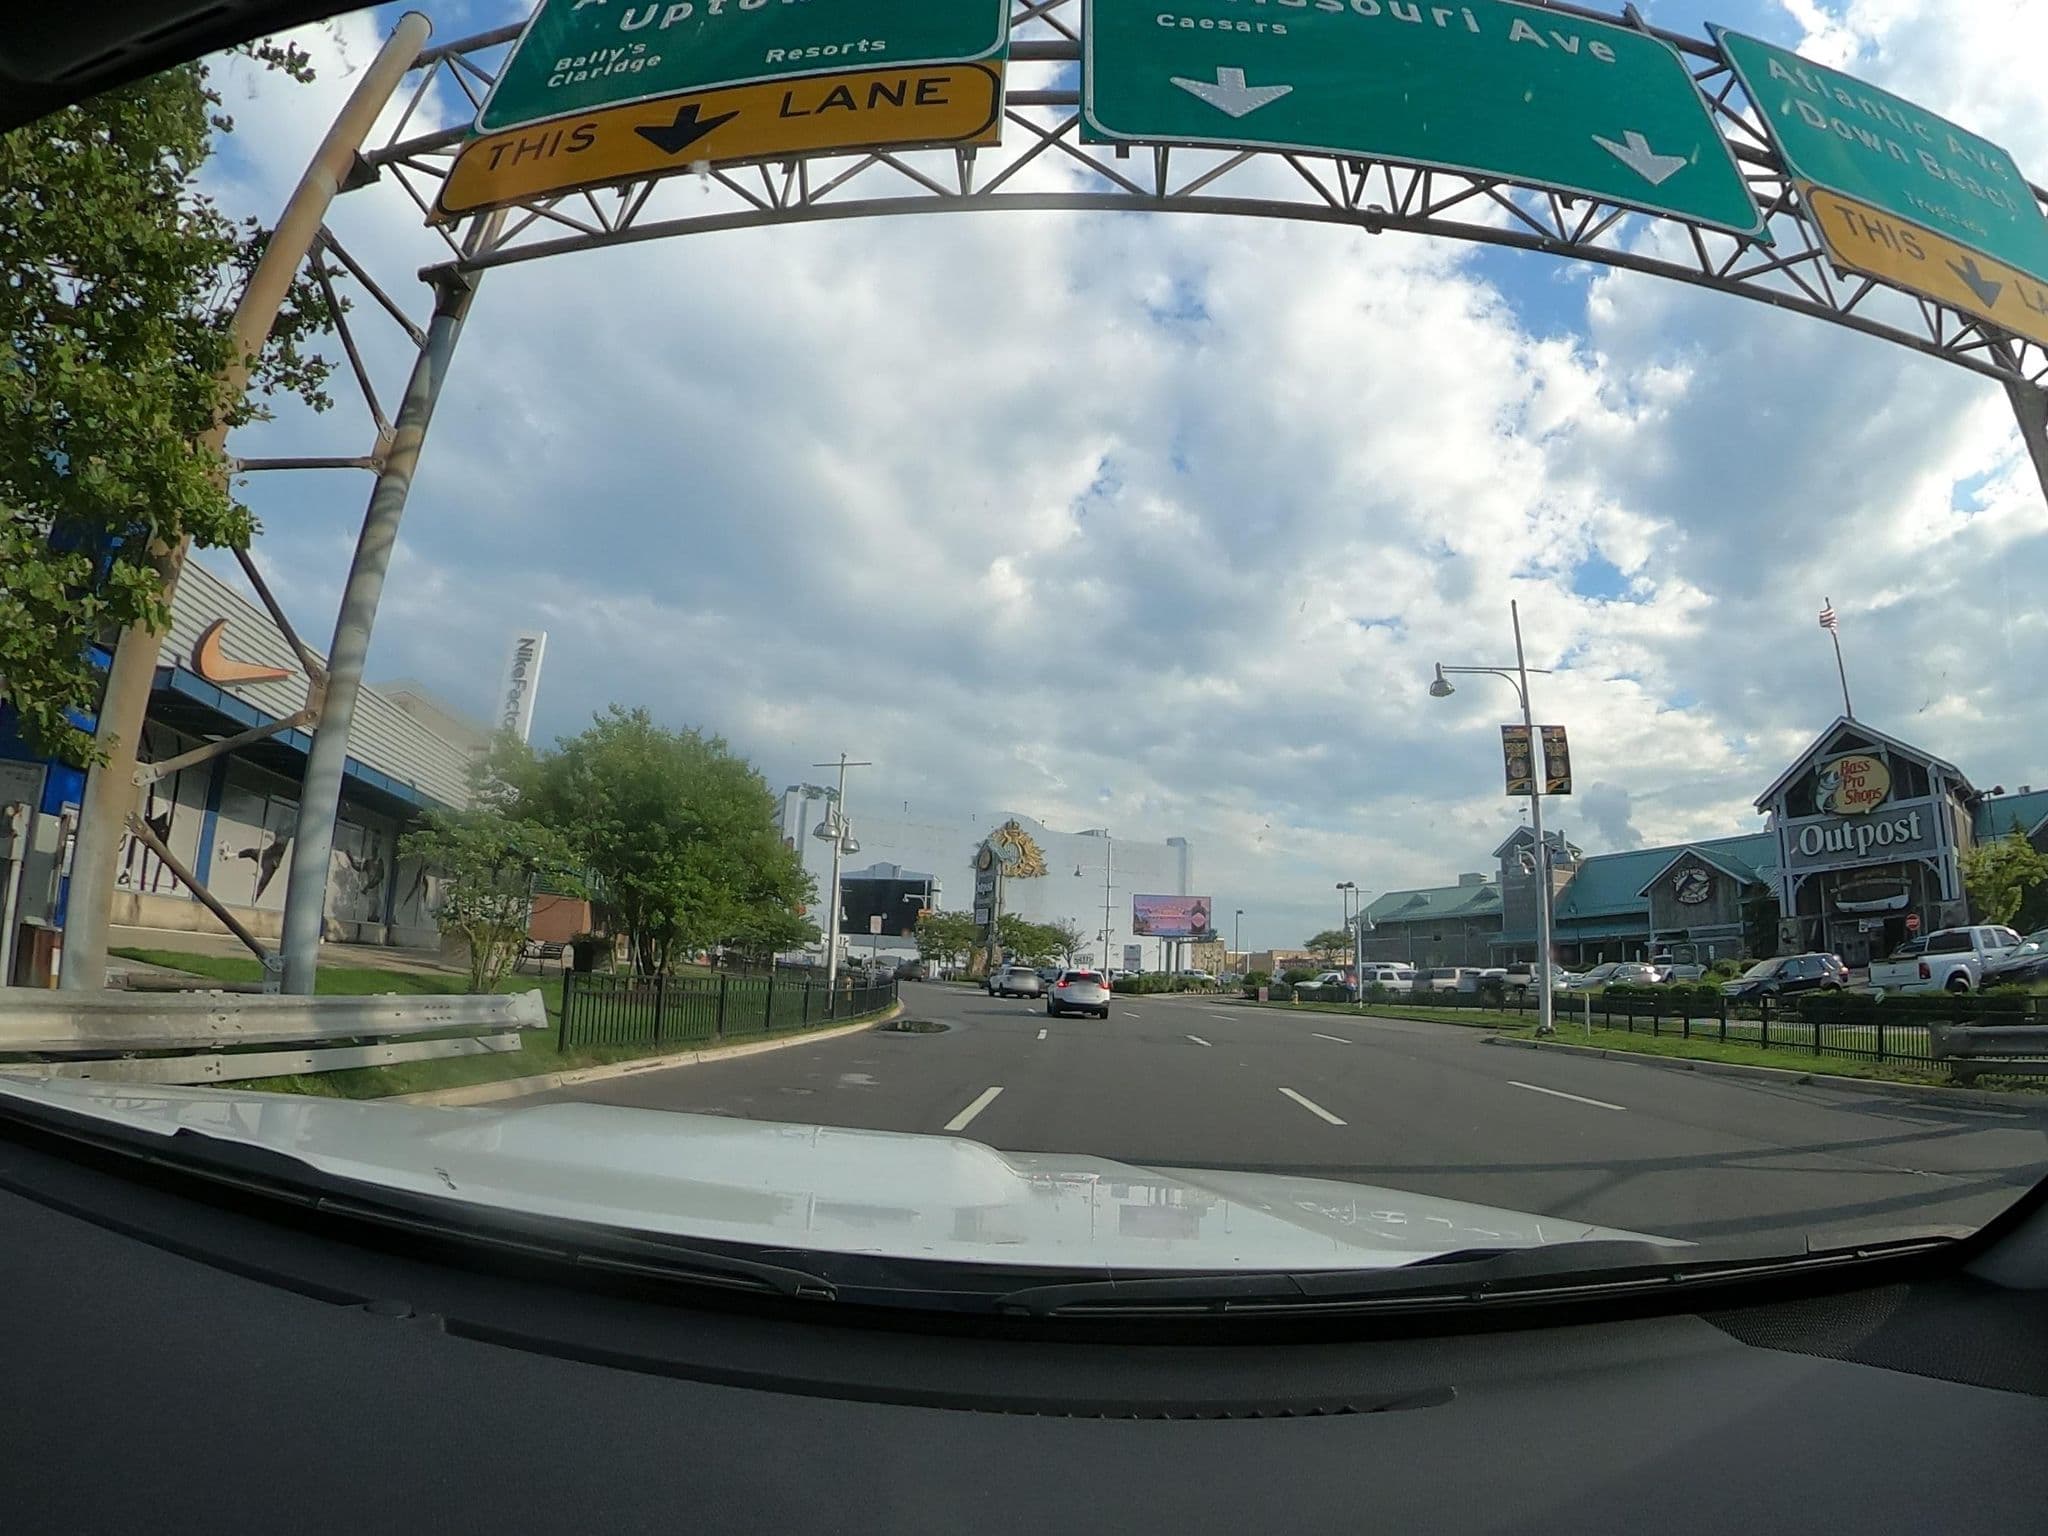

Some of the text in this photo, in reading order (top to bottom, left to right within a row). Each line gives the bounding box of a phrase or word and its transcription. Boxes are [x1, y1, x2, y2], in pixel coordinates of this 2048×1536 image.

[1156, 14, 1288, 35] Caesars
[1508, 18, 1616, 63] Ave
[554, 43, 647, 72] Bally's
[765, 37, 886, 64] Resorts
[547, 54, 662, 88] Claridge
[1768, 57, 1933, 143] Atlantic
[488, 77, 951, 171] THIS LANE
[1796, 98, 1911, 164] Down
[1833, 204, 1926, 261] THIS
[1840, 760, 1870, 776] Bass
[1843, 775, 1866, 790] Pro
[1844, 787, 1882, 805] Shops
[1799, 811, 1922, 856] Outpost
